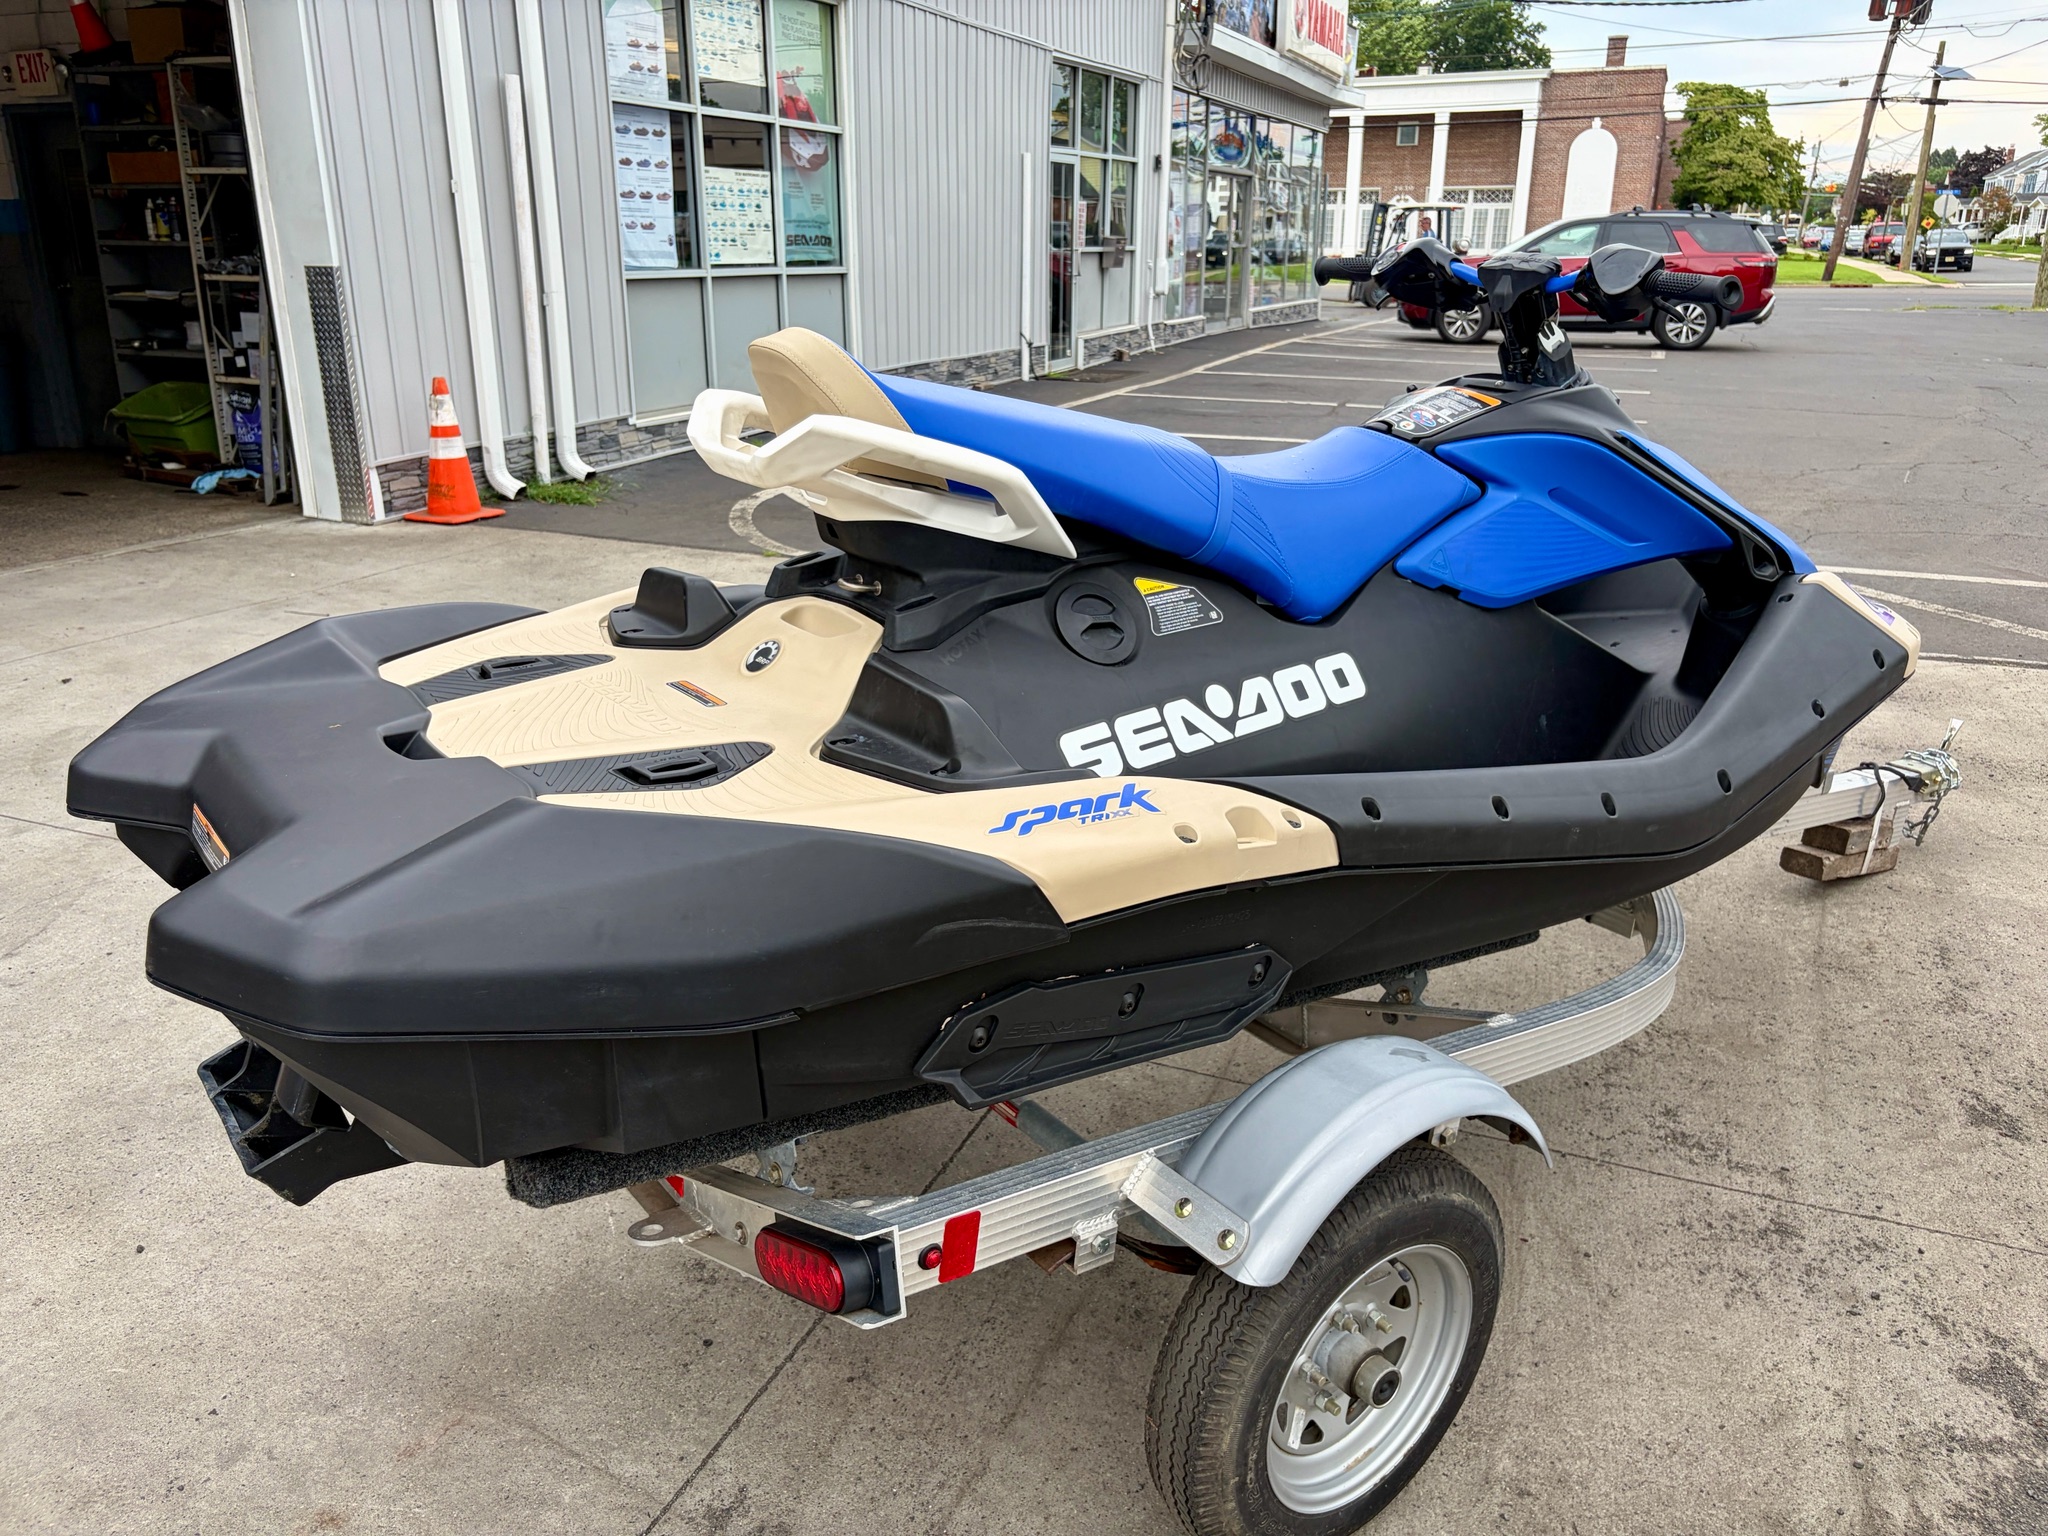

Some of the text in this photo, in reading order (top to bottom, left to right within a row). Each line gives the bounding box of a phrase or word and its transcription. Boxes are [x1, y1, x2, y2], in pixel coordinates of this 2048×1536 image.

[1307, 0, 1345, 58] YAMAHA
[16, 52, 47, 84] EXIT
[1078, 808, 1133, 825] TRIXX
